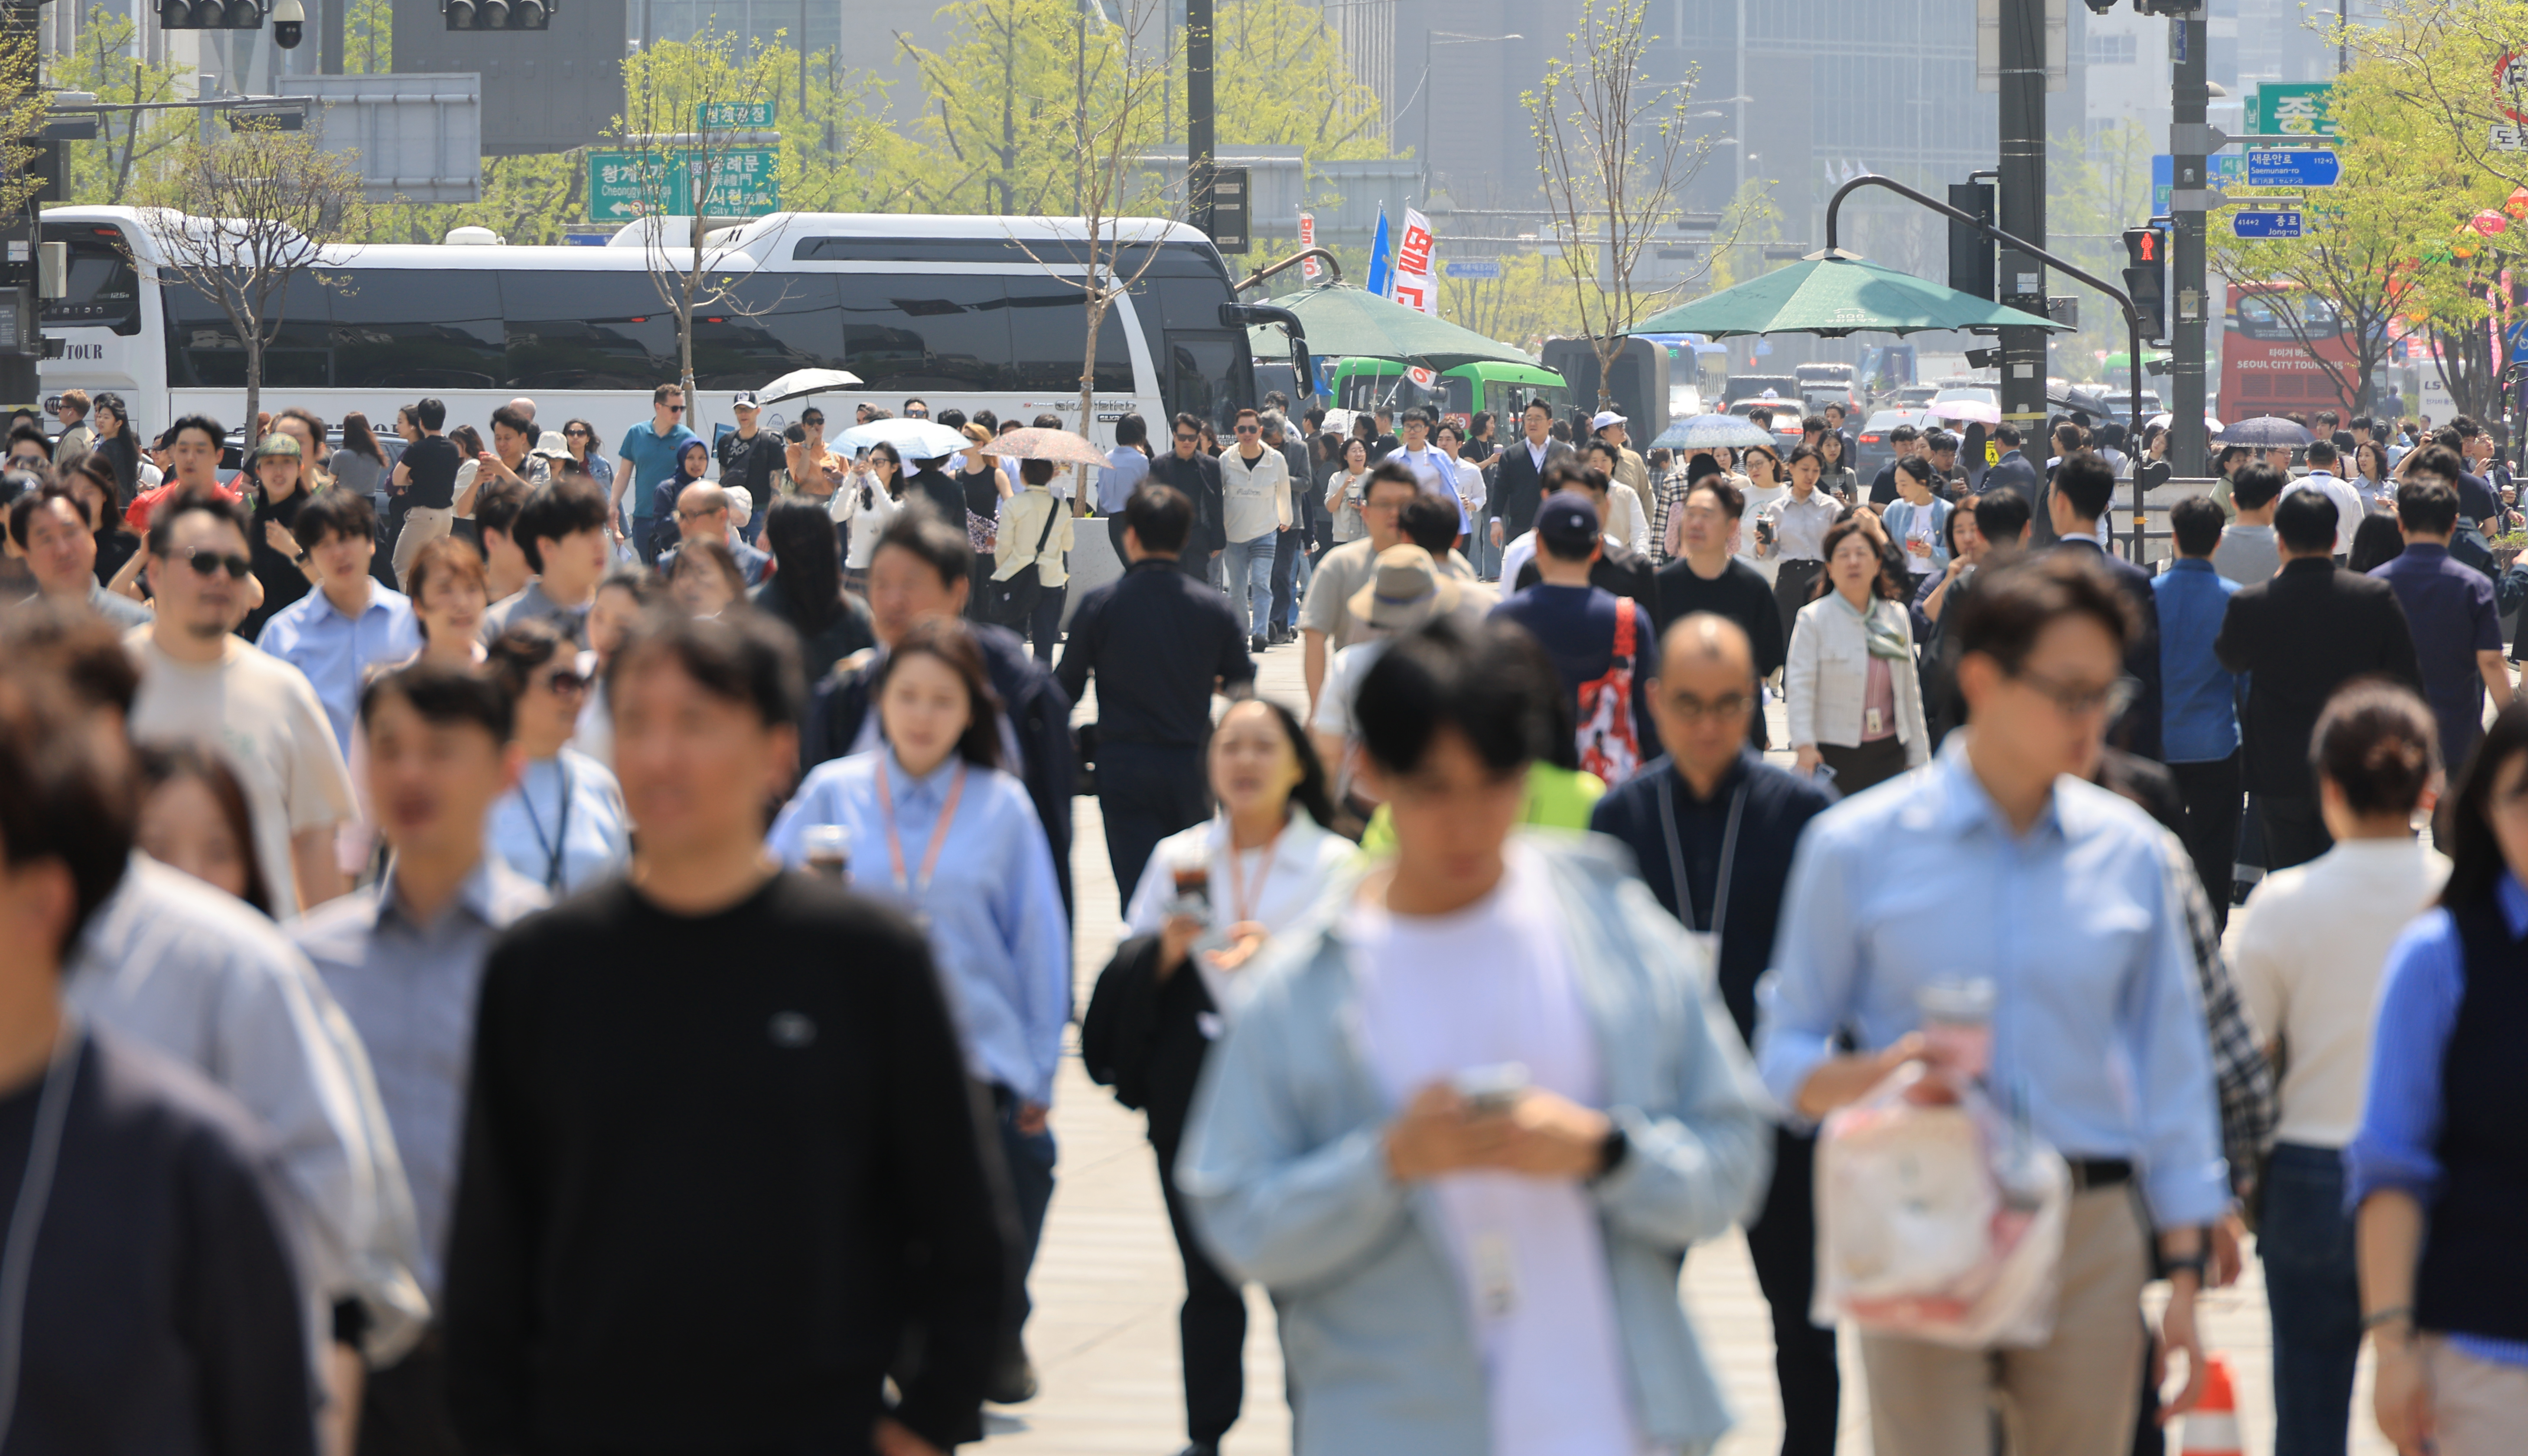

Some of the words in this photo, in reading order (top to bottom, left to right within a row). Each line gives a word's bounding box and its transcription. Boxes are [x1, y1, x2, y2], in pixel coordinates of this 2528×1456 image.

[2251, 153, 2293, 165] 새문안로
[710, 206, 729, 216] City
[733, 206, 751, 215] Hall
[66, 344, 103, 360] TOUR
[2269, 348, 2293, 357] 타이거
[2425, 381, 2441, 390] LS
